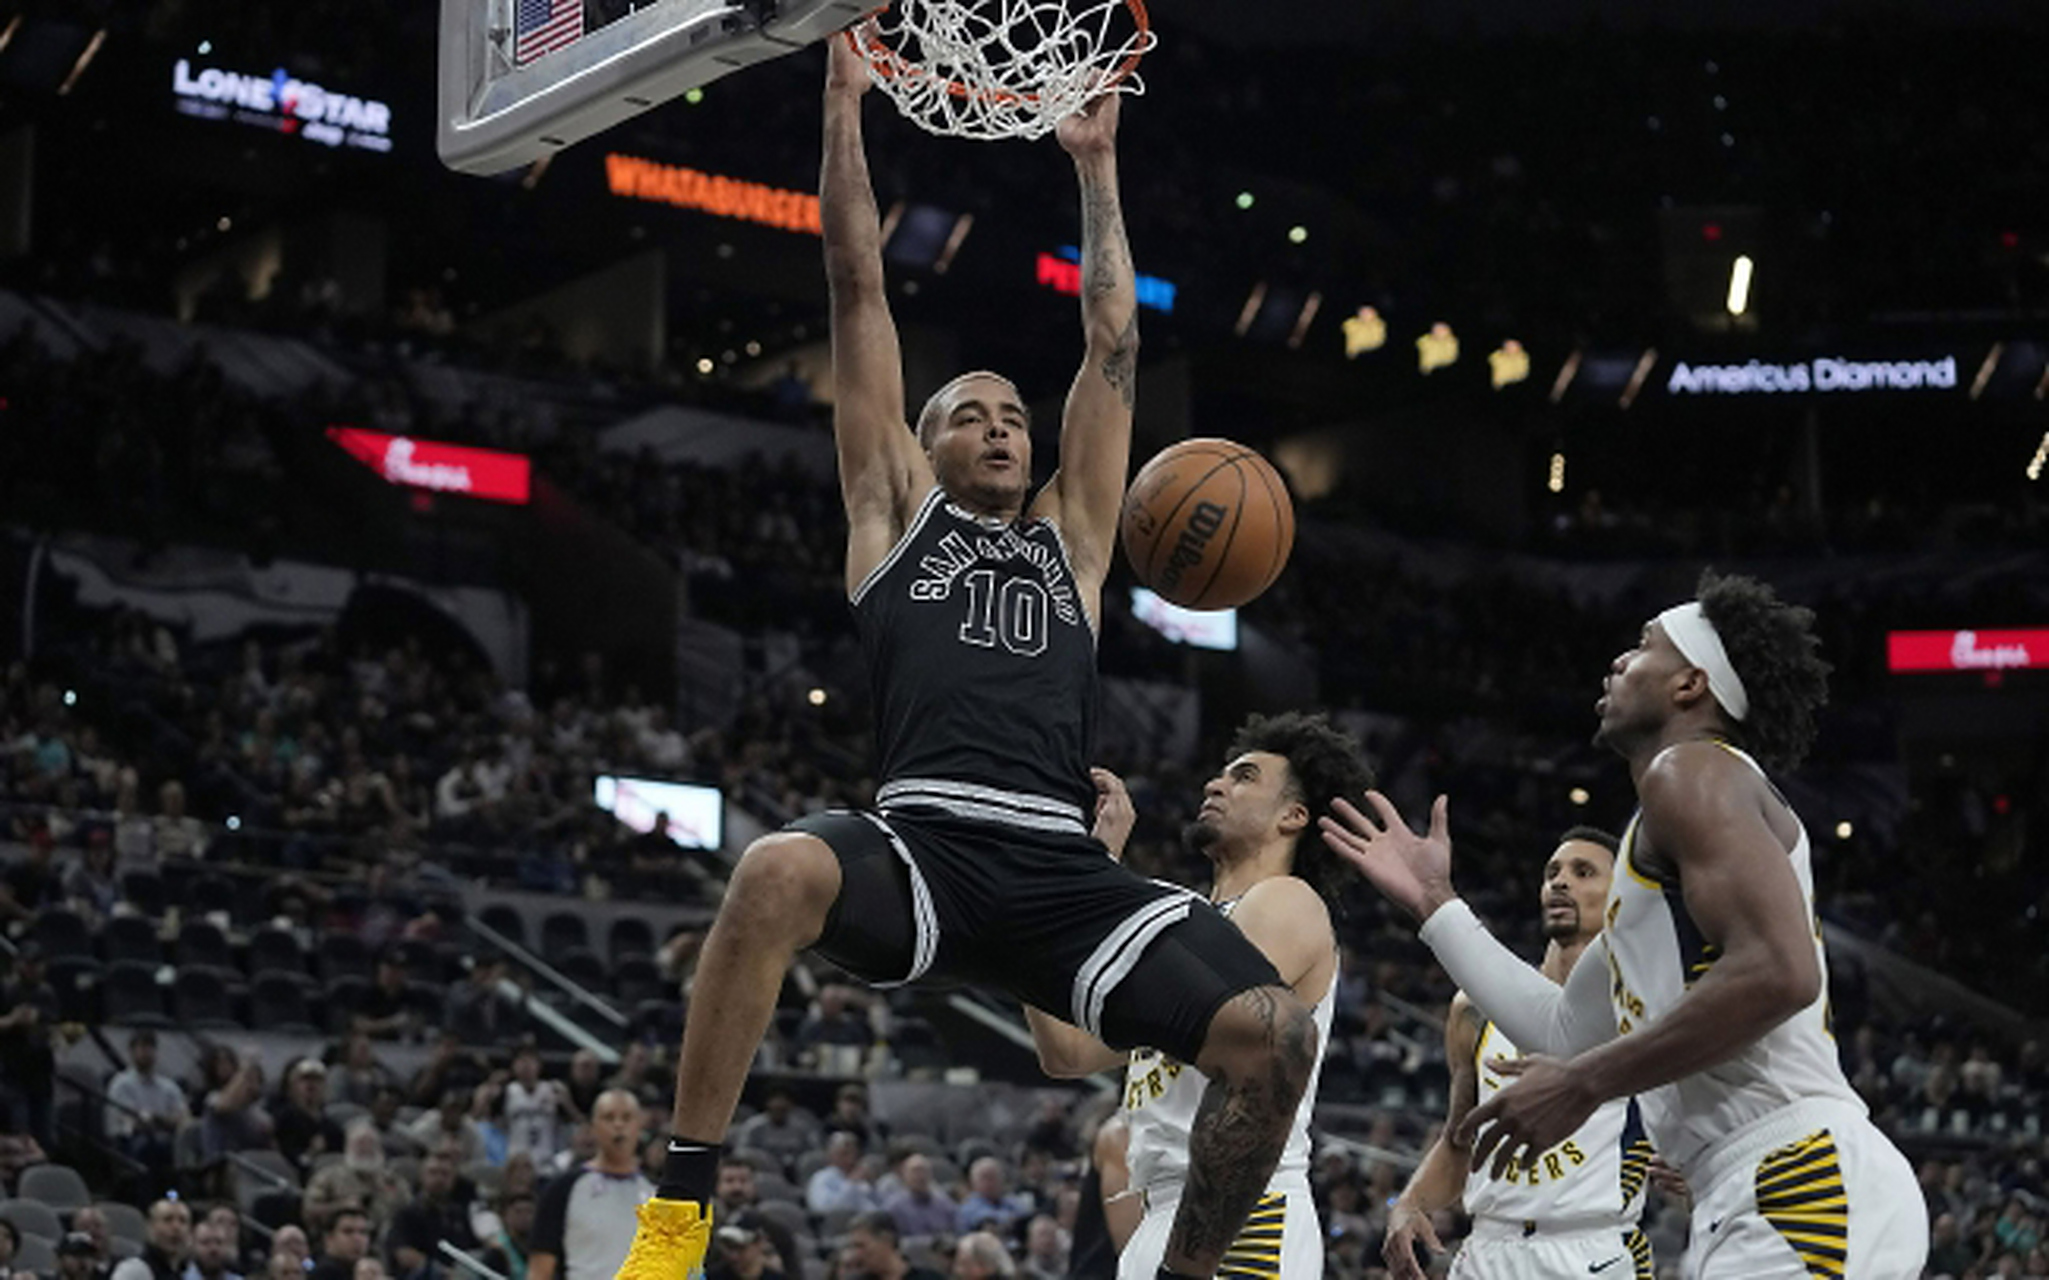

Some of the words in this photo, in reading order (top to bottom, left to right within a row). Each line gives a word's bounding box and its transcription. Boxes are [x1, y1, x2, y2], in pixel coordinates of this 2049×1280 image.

[173, 59, 275, 111] LONE
[294, 82, 391, 134] STAR
[1668, 359, 1811, 393] Americus
[1813, 355, 1957, 391] Diamond
[910, 530, 979, 600] SAN
[1159, 499, 1229, 593] Wilson
[959, 568, 1048, 657] 10
